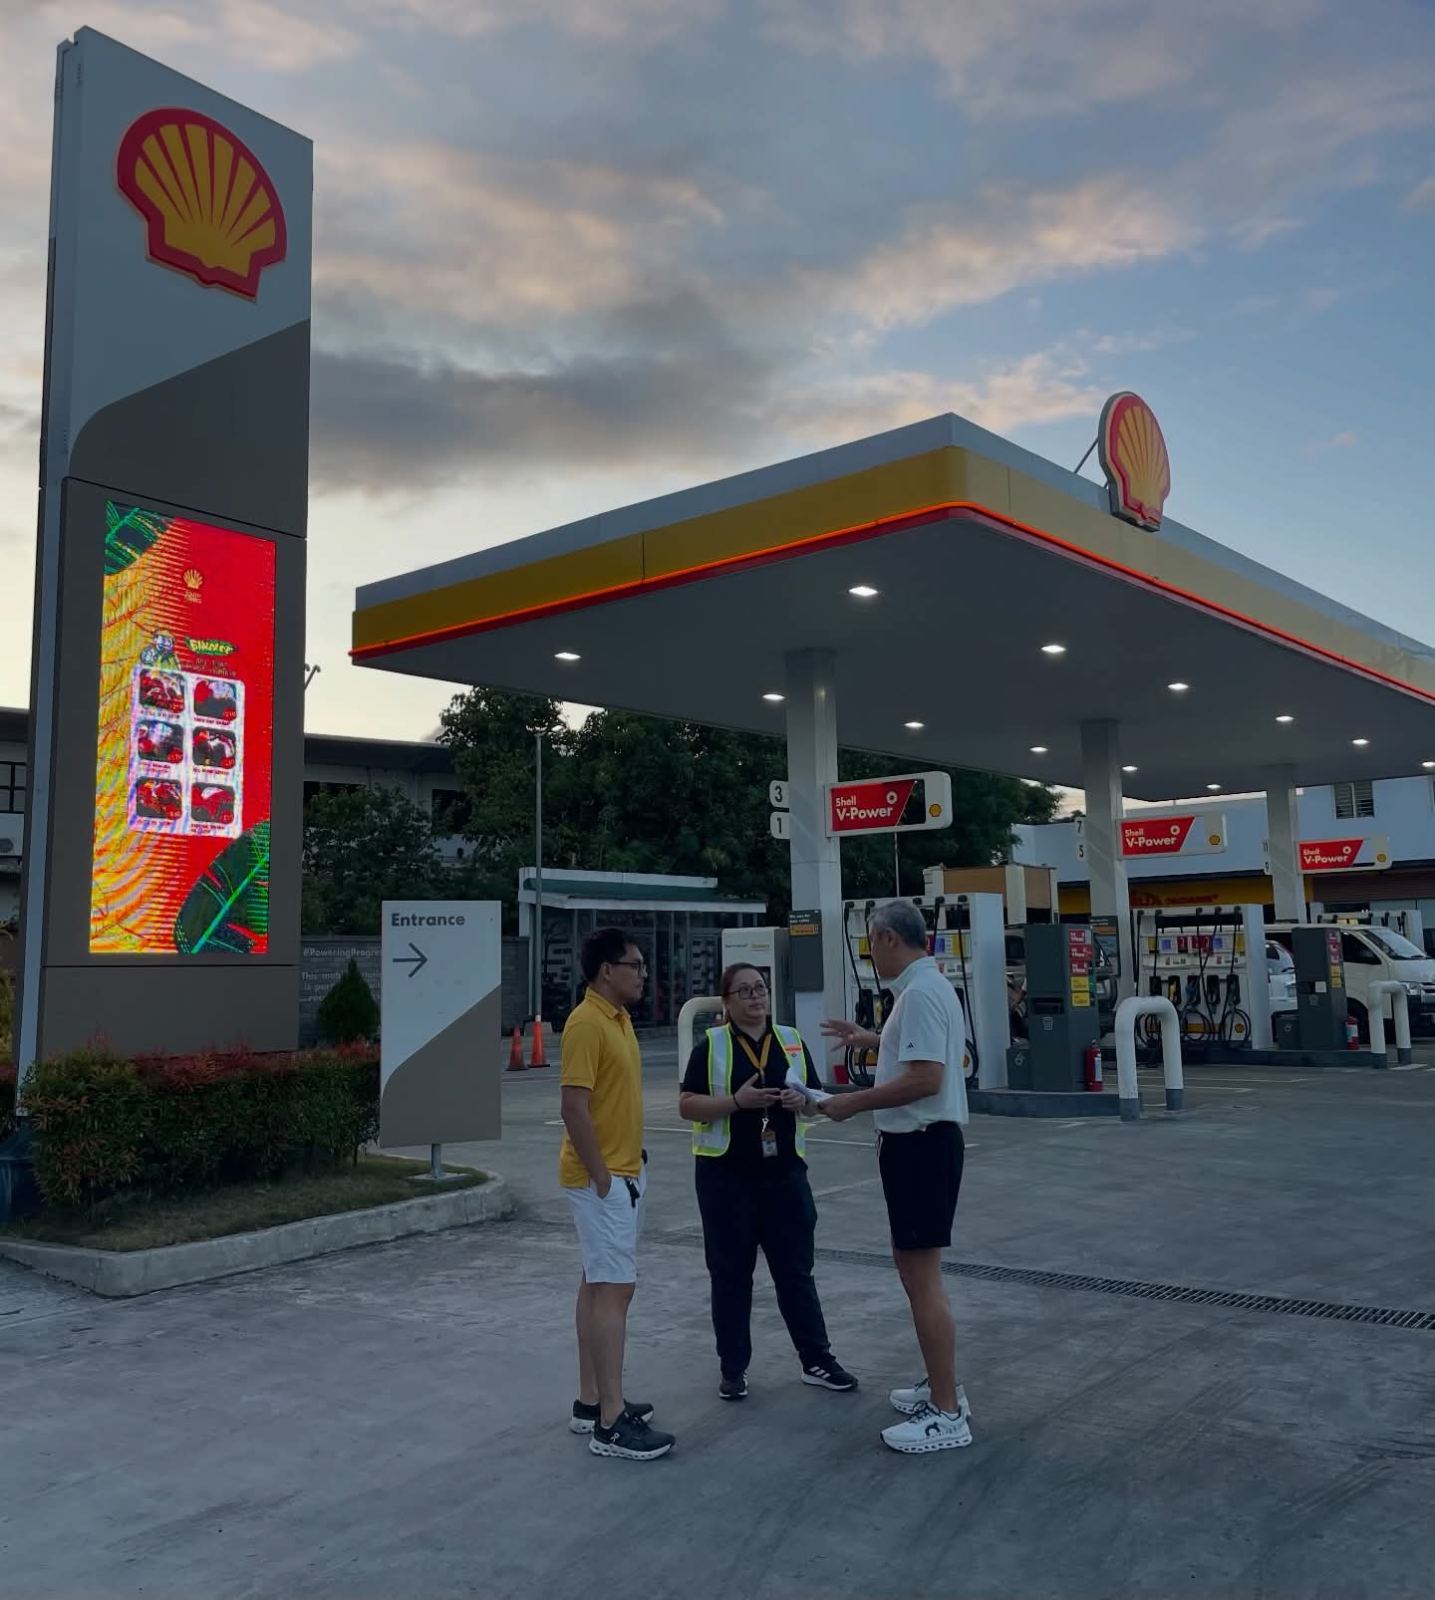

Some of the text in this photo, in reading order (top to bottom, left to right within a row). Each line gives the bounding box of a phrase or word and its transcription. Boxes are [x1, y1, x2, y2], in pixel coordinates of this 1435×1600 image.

[774, 785, 783, 802] 3
[835, 795, 856, 807] Shell
[836, 806, 894, 821] V-Power
[776, 817, 782, 833] 1
[1076, 821, 1082, 833] 7
[1125, 828, 1144, 837] Shell
[1126, 836, 1177, 848] V-Power
[1078, 845, 1084, 857] 5
[1304, 854, 1349, 865] V-Power
[391, 912, 465, 926] Entrance
[304, 947, 380, 959] #PoweringProgre
